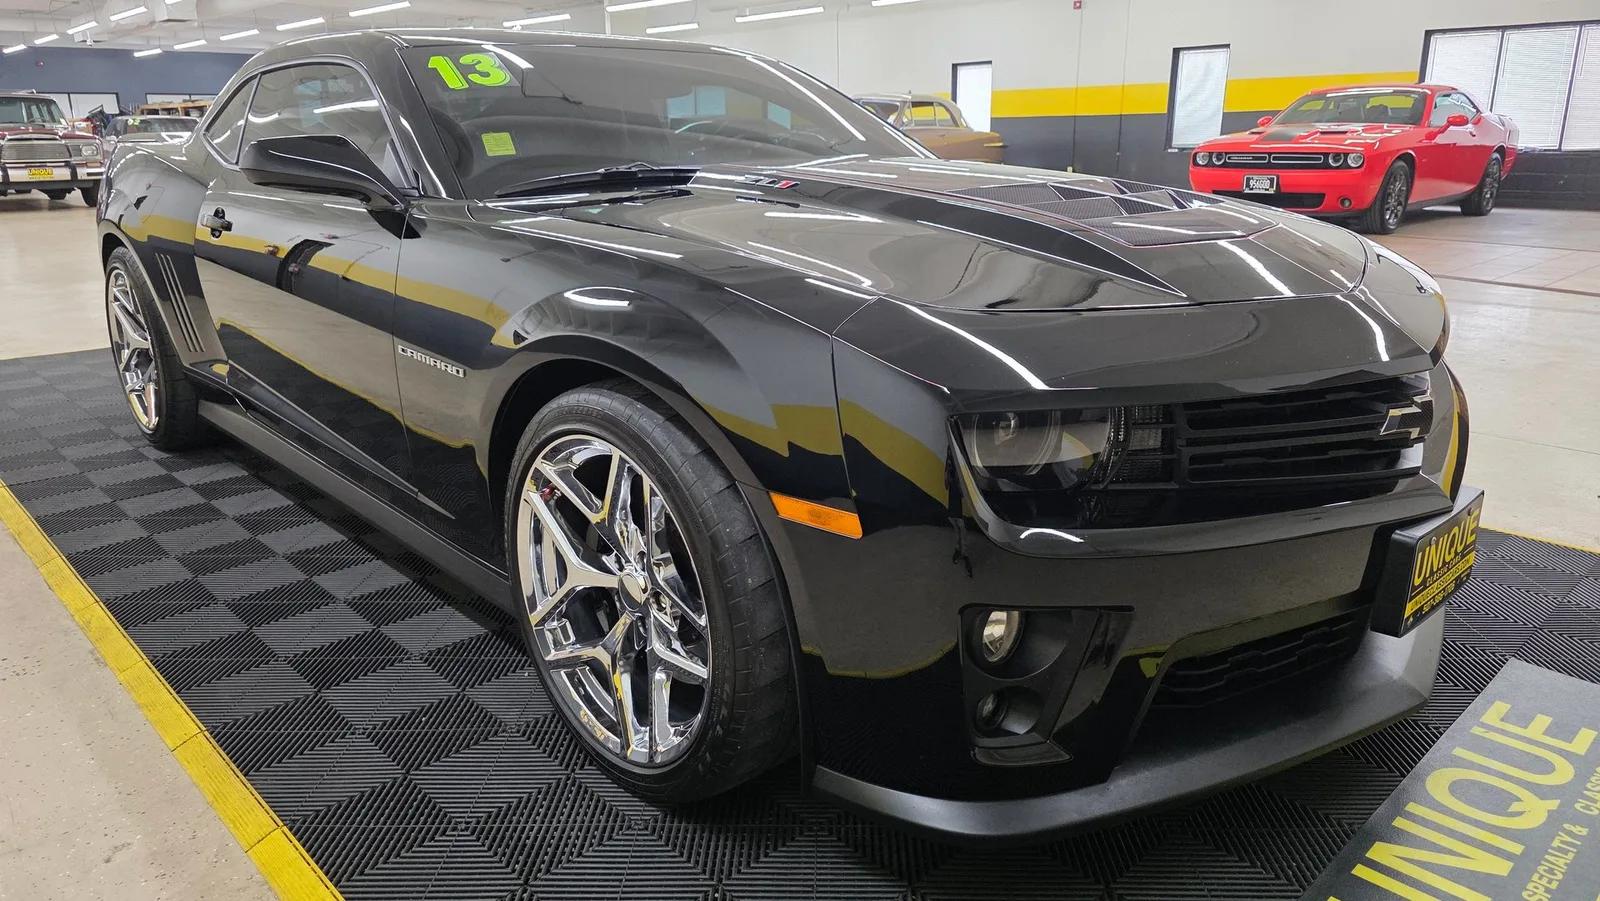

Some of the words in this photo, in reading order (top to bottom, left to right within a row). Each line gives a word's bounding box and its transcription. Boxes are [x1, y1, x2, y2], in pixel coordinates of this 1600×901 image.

[427, 53, 511, 90] 13
[397, 344, 466, 378] CAMARO
[1414, 511, 1479, 586] UNIQUE
[1426, 563, 1449, 586] CLASSIC
[1521, 831, 1583, 901] SPECIALTY
[1562, 823, 1589, 836] &
